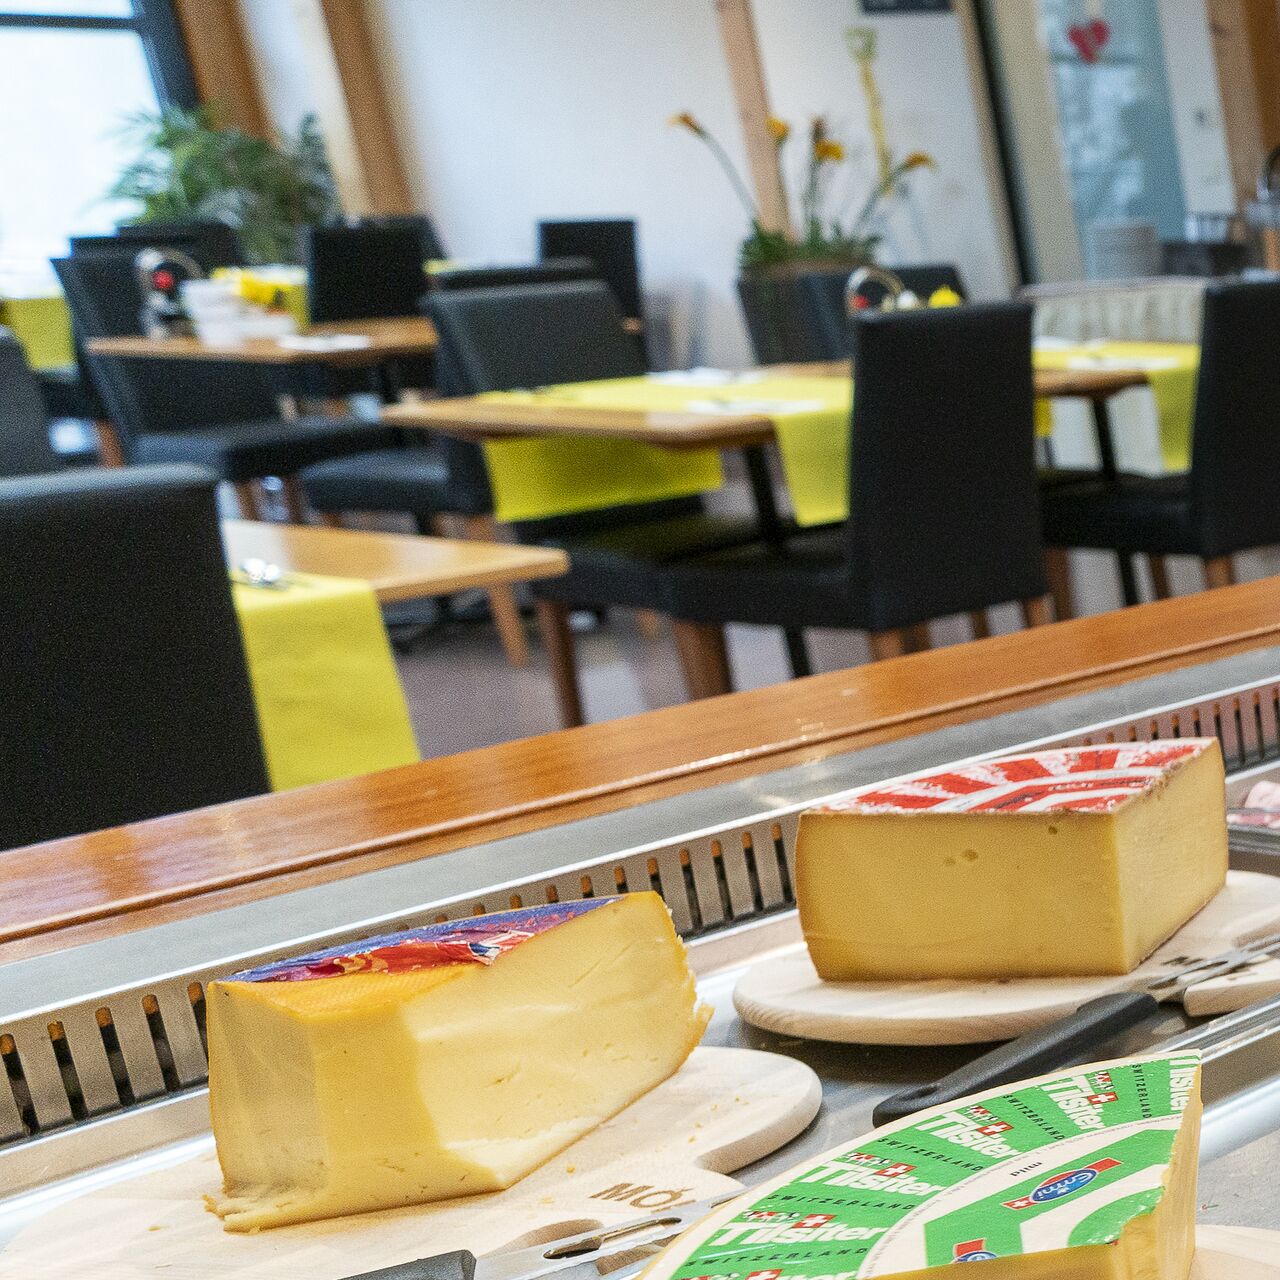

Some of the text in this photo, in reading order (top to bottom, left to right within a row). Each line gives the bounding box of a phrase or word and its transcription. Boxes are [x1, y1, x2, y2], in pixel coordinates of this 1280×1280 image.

[1040, 1076, 1106, 1130] Tilsiter
[1131, 1064, 1152, 1118] SWITZERLAND
[1002, 1094, 1065, 1140] SWITZERLAND
[915, 1112, 1022, 1159] Tilsiter
[877, 1137, 985, 1172] SWITZERLAND
[1010, 1161, 1043, 1177] mild
[800, 1160, 947, 1196] Tilsiter
[1038, 1171, 1094, 1200] Emmi
[767, 1194, 917, 1210] SWITZERLAND
[708, 1221, 889, 1247] Tilsiter
[683, 1248, 869, 1267] SWITZERLAND
